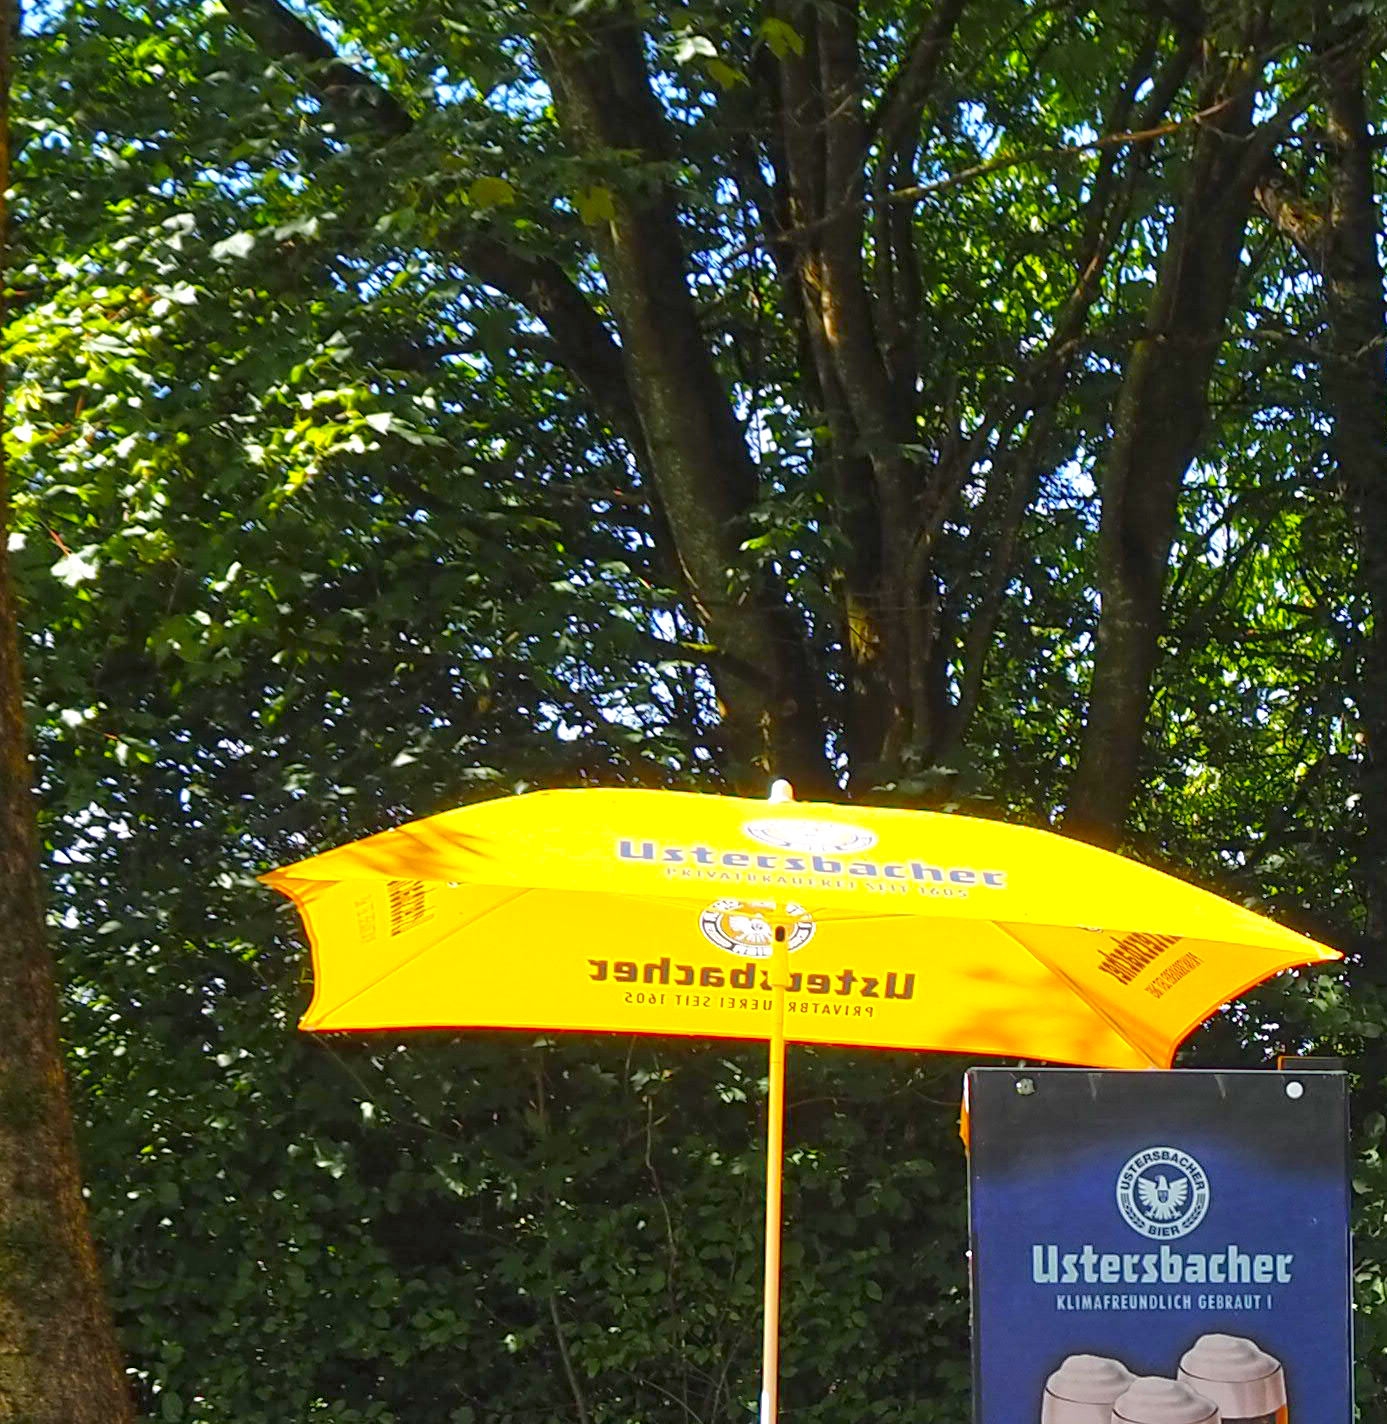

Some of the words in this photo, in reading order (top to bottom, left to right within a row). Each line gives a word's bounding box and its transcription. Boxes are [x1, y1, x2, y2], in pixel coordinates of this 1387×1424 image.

[618, 840, 1008, 886] Ustersbacher
[1119, 1150, 1206, 1192] USTERSBACHER
[1148, 1225, 1181, 1238] BIER
[1032, 1245, 1295, 1284] Ustersbacher
[1056, 1294, 1192, 1311] KLIMAFREUNDLICH
[1198, 1293, 1262, 1310] GEBRAUT
